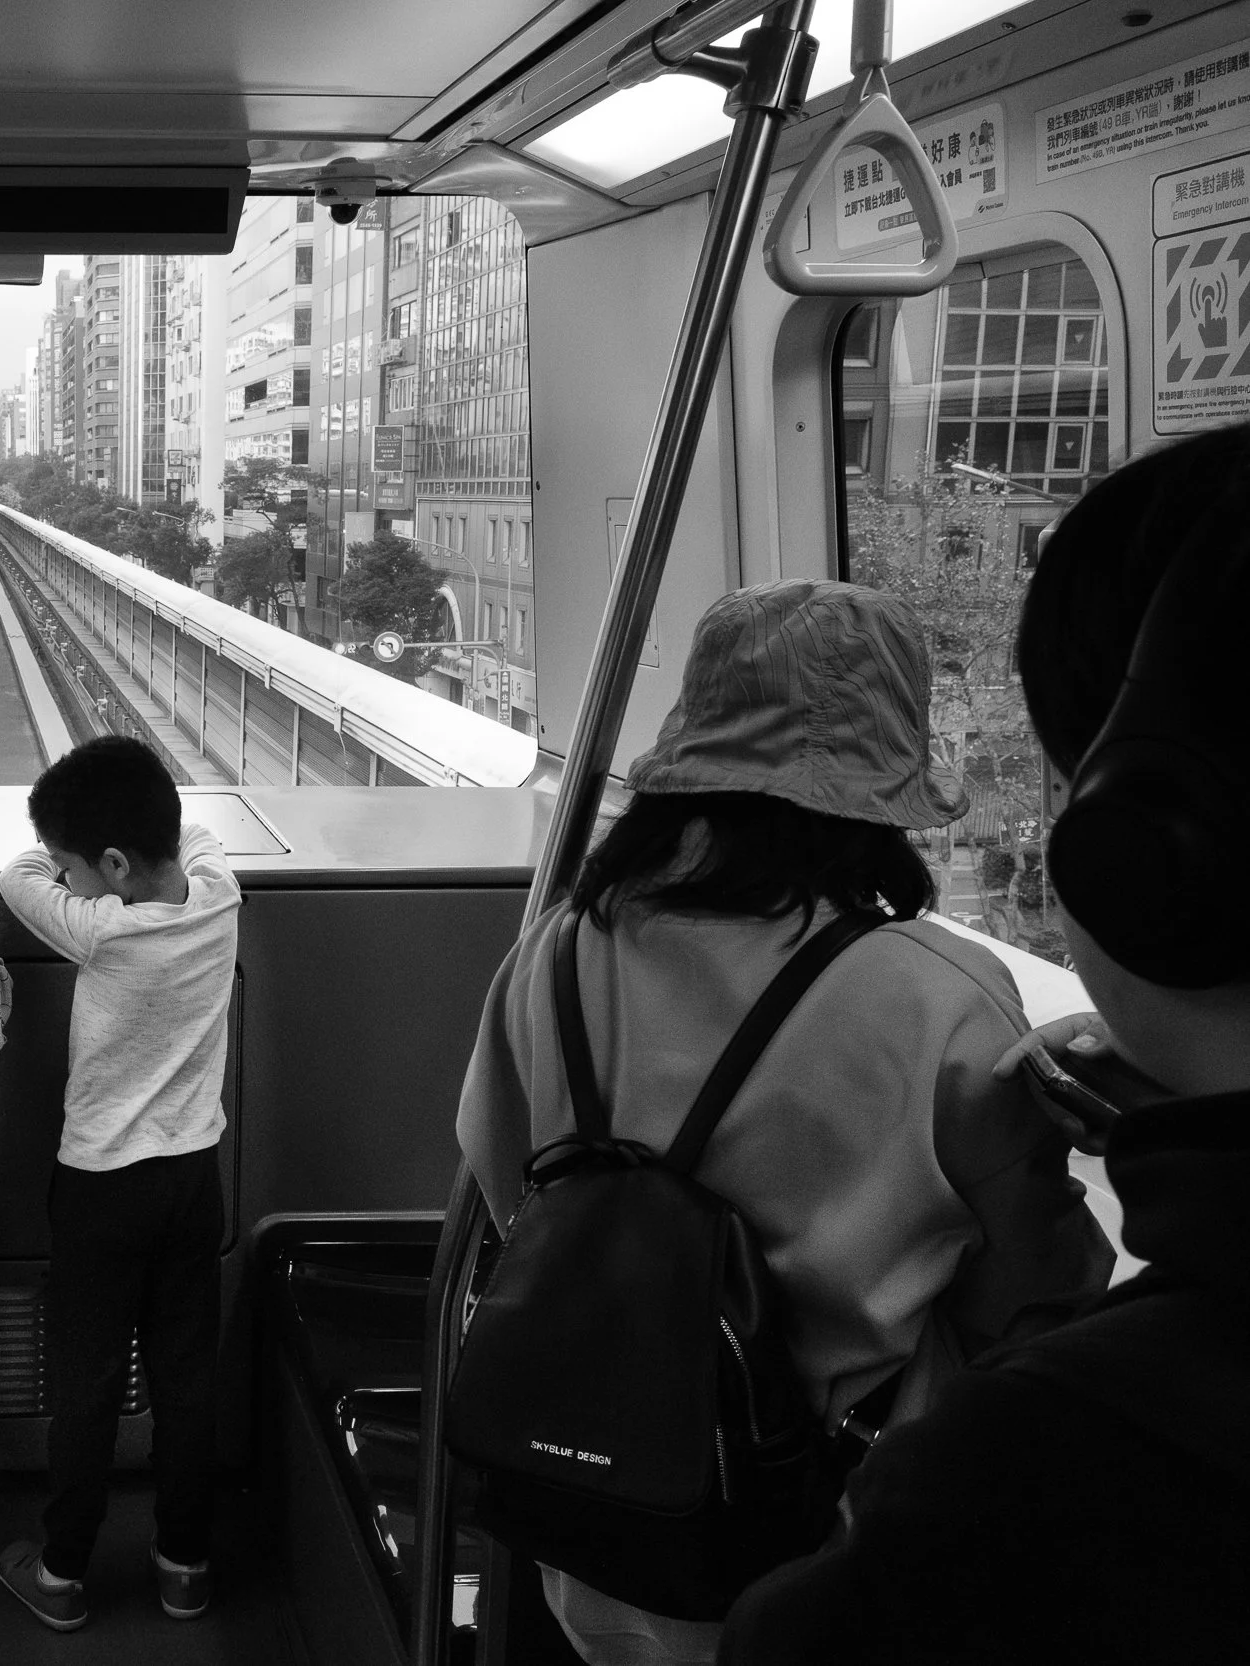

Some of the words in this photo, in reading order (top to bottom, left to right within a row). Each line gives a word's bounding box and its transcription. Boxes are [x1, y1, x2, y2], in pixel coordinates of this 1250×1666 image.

[1195, 105, 1217, 121] please
[1227, 98, 1237, 108] us
[1116, 142, 1133, 155] using
[1133, 138, 1145, 149] this
[1174, 123, 1195, 136] Thank
[1175, 166, 1246, 202] 緊急對講機
[1173, 204, 1214, 221] Emergency
[1215, 196, 1250, 211] Intercom
[530, 1440, 574, 1458] SKYBLUE
[577, 1451, 612, 1466] DESIGN
